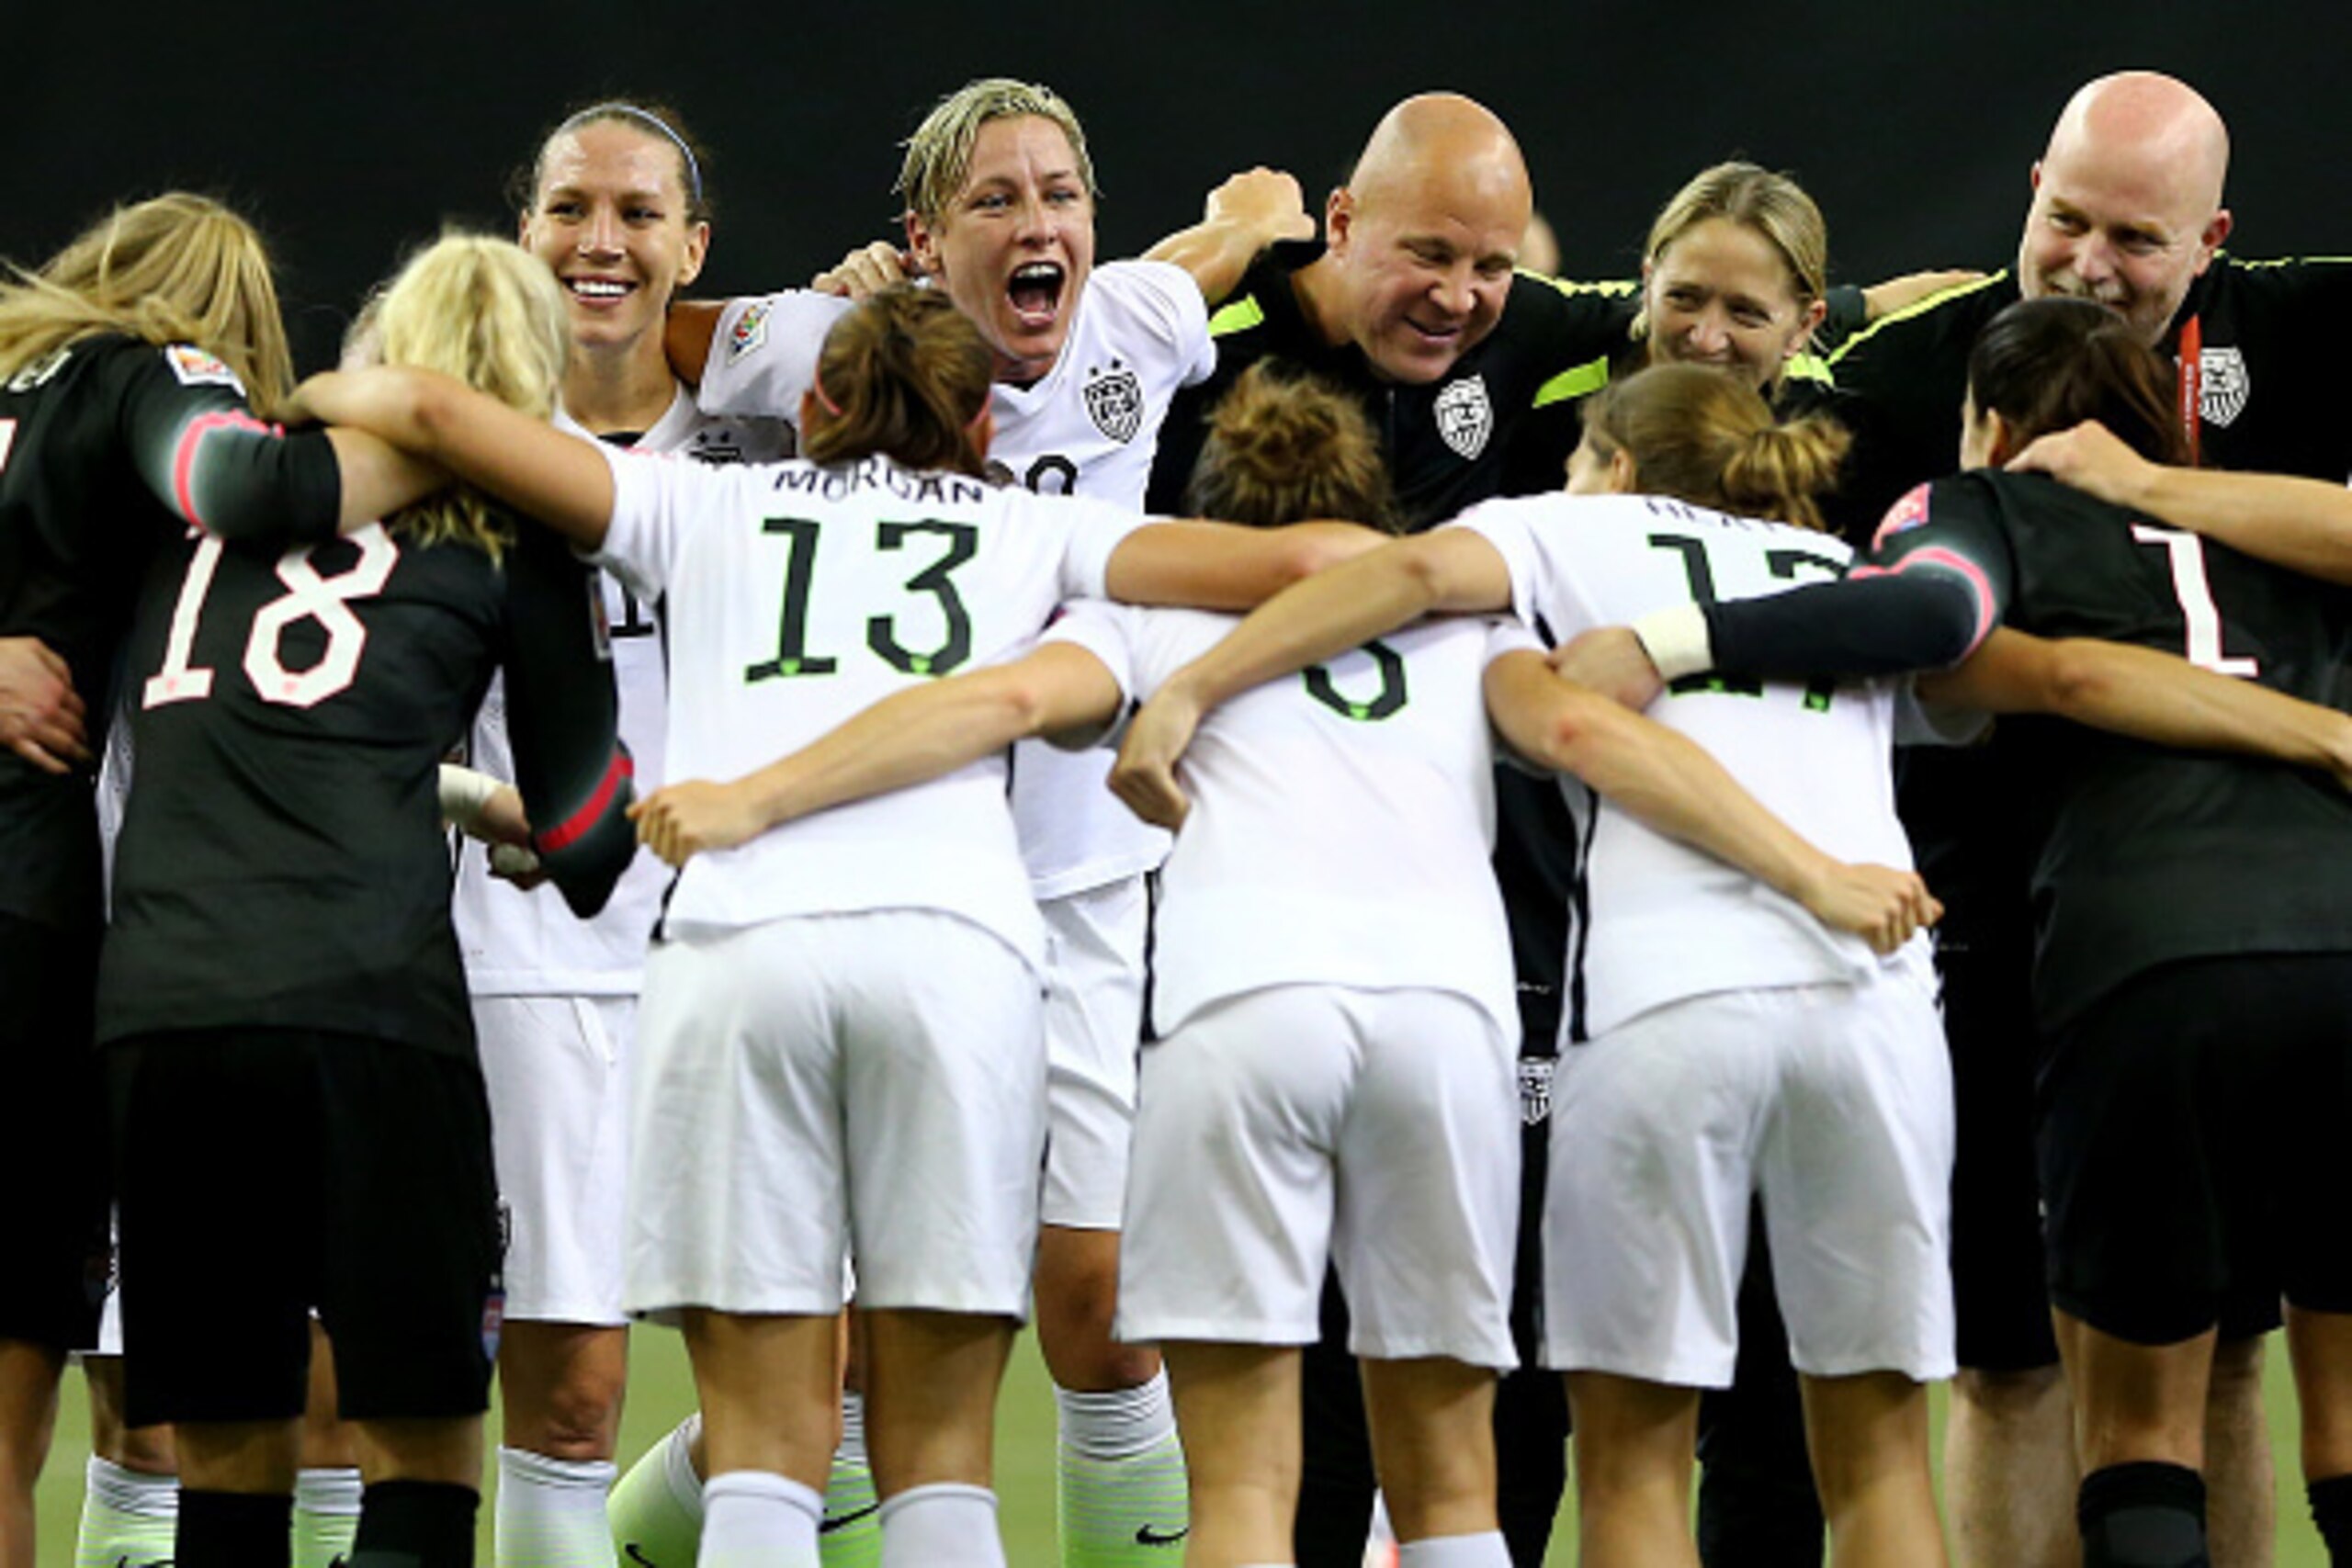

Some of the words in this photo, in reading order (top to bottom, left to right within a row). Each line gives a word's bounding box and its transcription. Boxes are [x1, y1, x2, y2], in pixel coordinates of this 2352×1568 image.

[774, 457, 984, 503] MORGAN
[141, 518, 401, 710] 18
[745, 516, 978, 682] 13
[2129, 521, 2260, 678] 1
